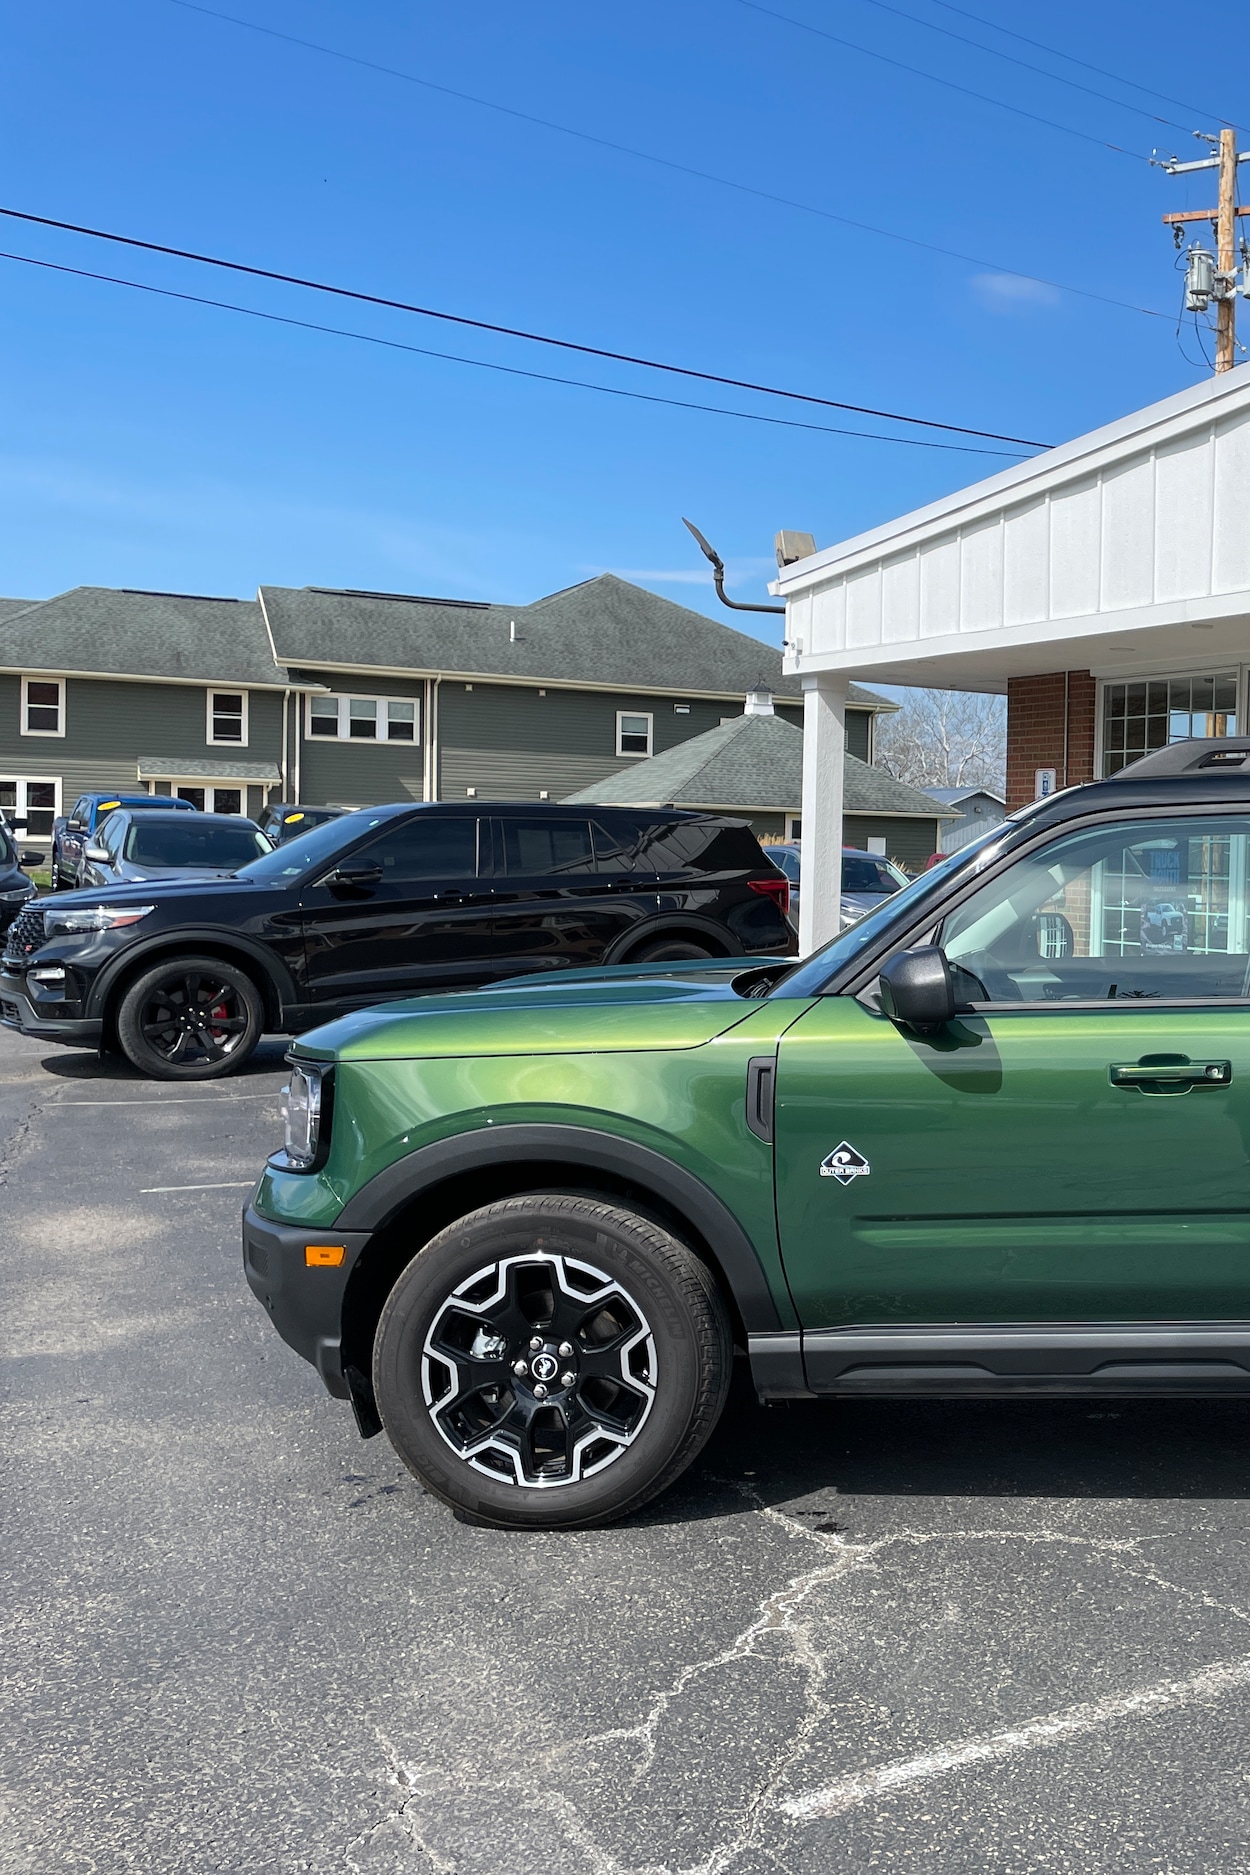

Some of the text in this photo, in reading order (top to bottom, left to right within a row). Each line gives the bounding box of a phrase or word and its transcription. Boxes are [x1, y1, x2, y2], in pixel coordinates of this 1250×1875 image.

[1150, 851, 1180, 868] TRUCK
[1150, 869, 1180, 885] MONTH
[845, 1167, 868, 1175] BANKS
[628, 1260, 684, 1339] MICHELIN
